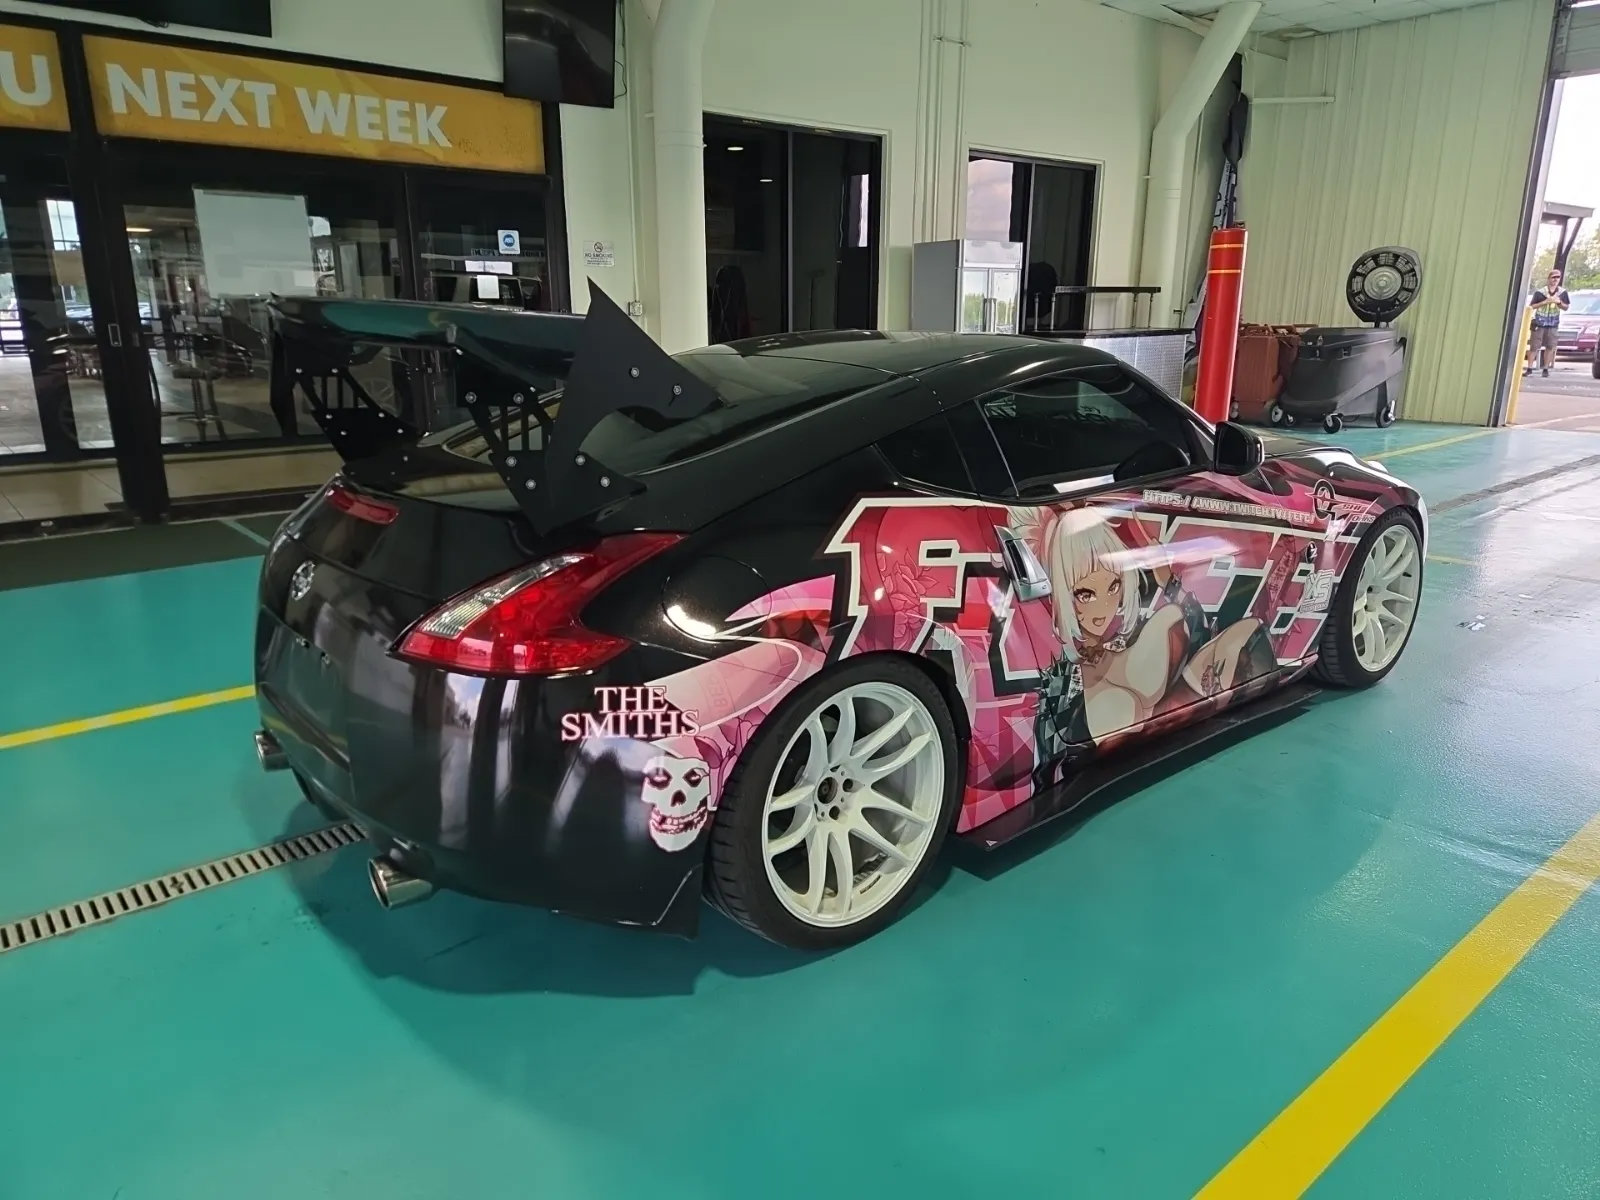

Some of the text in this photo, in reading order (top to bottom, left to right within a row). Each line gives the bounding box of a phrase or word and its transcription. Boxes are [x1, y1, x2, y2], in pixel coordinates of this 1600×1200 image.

[105, 62, 277, 128] NEXT
[294, 86, 453, 148] WEEK
[593, 685, 668, 714] THE
[560, 708, 701, 741] SMITHS
